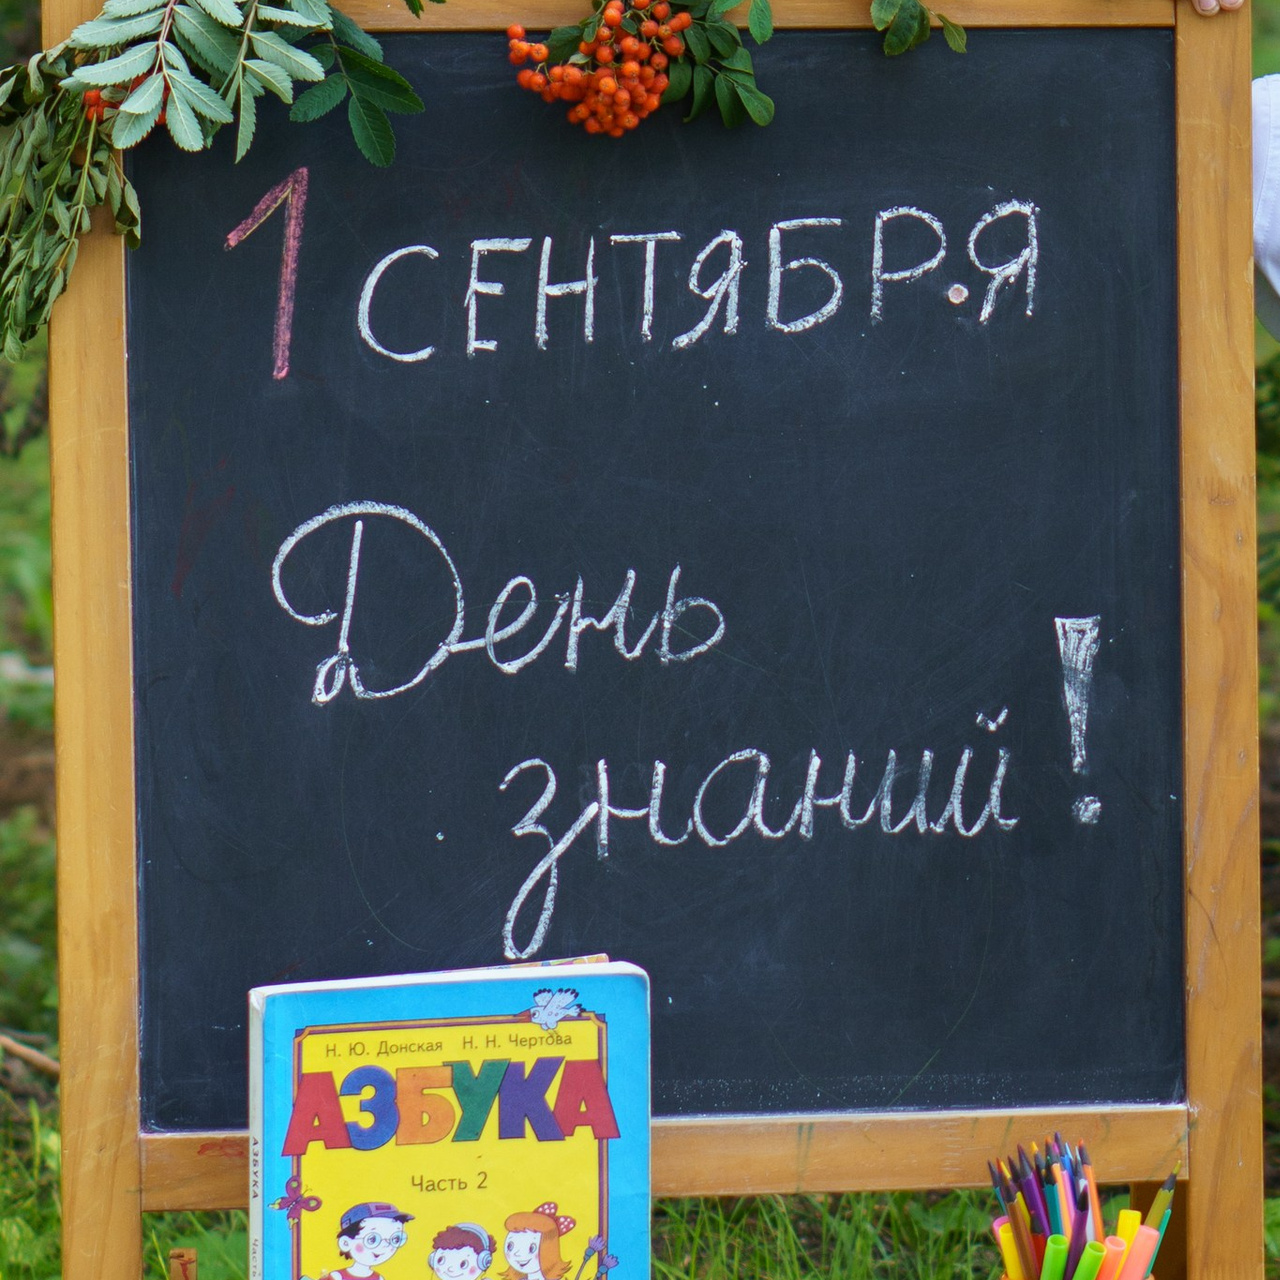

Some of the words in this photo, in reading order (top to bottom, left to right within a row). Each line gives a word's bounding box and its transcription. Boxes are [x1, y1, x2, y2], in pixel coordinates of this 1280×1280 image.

[224, 166, 309, 380] 1
[271, 500, 725, 705] День
[326, 1043, 341, 1058] Н.
[349, 1041, 370, 1057] Ю.
[376, 1039, 443, 1058] Донская
[462, 1035, 478, 1050] Н.
[486, 1034, 501, 1049] Н.
[508, 1033, 572, 1049] Чертова
[281, 1056, 621, 1156] АЗБУКА
[411, 1174, 468, 1193] Часть
[476, 1171, 488, 1190] 2
